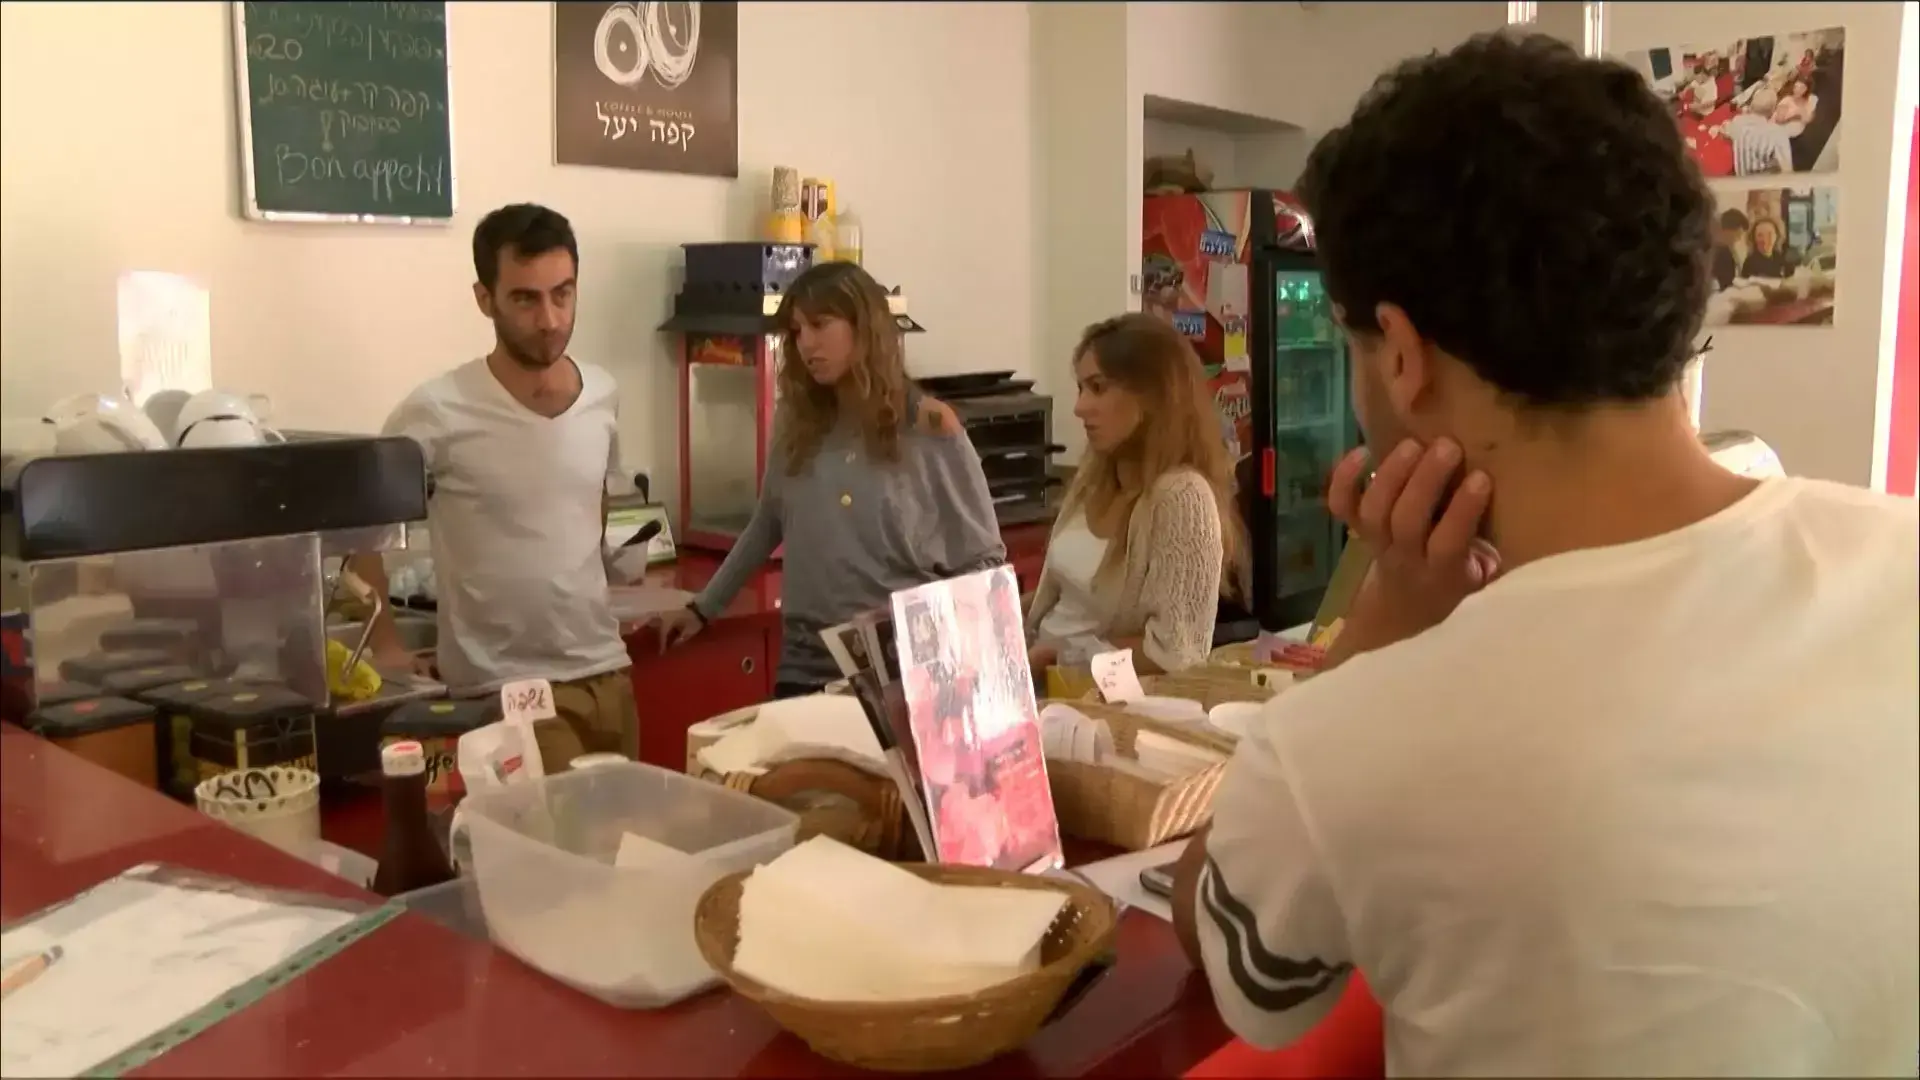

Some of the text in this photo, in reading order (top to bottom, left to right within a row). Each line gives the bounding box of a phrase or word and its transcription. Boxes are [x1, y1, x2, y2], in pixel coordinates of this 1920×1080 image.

[382, 84, 430, 122] קפה
[596, 101, 695, 152] קפה יעל
[275, 143, 346, 188] Bon
